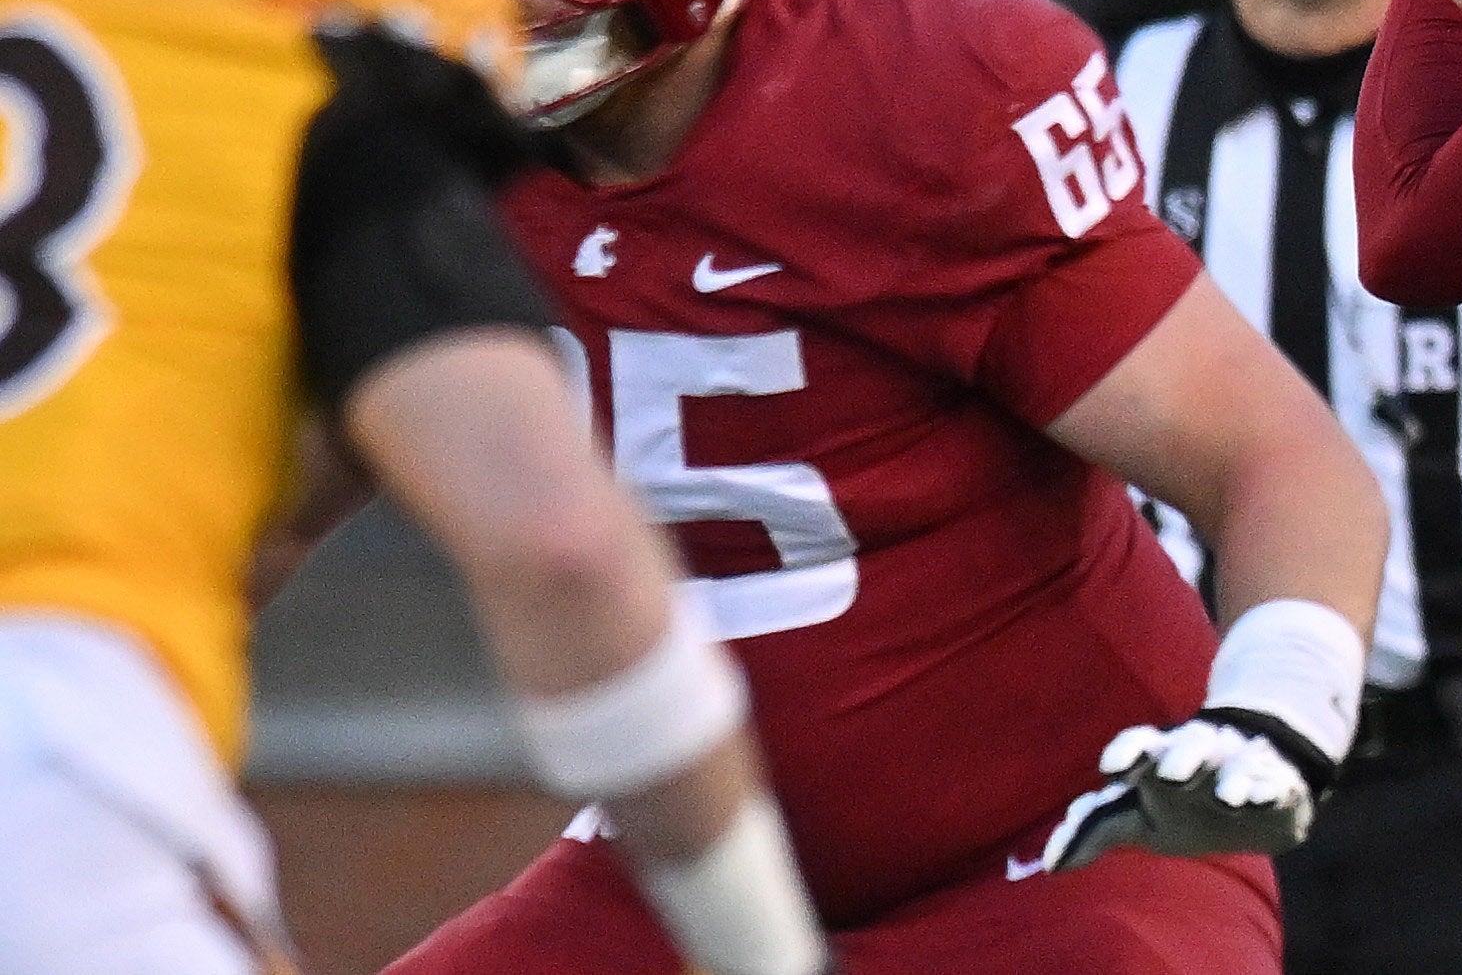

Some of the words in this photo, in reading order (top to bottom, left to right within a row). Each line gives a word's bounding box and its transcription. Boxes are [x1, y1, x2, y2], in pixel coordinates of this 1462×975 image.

[1011, 50, 1139, 239] 65
[1404, 320, 1456, 391] R
[555, 326, 859, 643] 5
